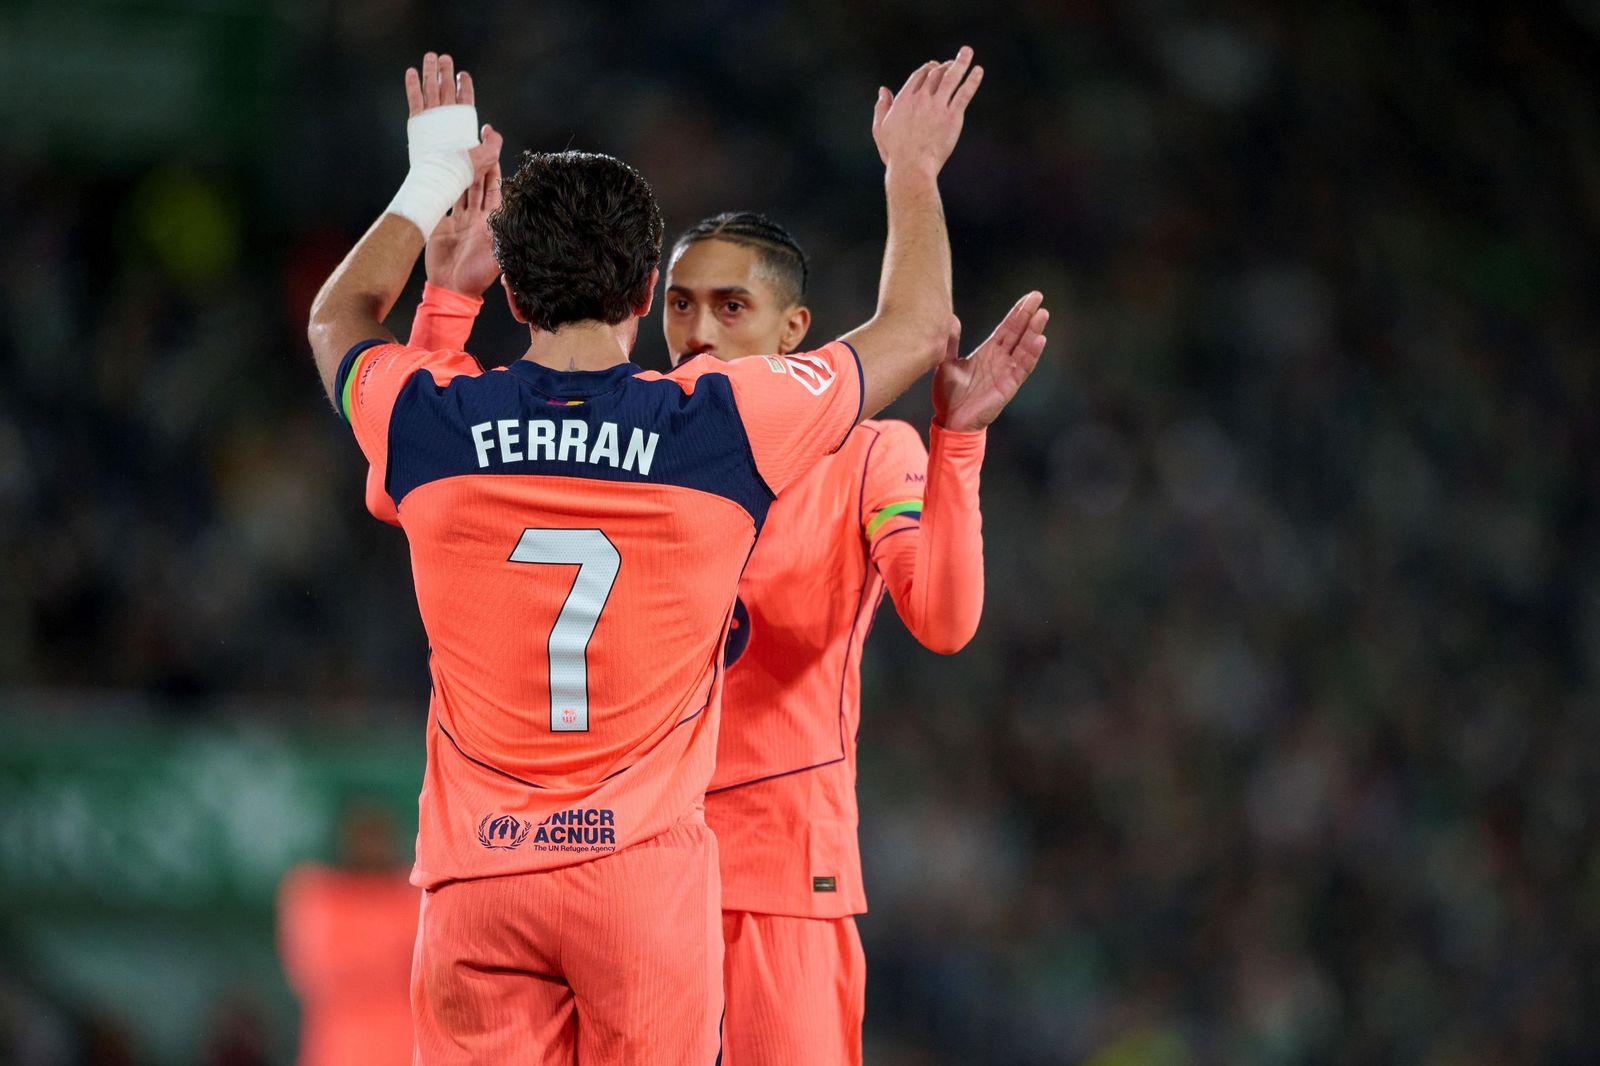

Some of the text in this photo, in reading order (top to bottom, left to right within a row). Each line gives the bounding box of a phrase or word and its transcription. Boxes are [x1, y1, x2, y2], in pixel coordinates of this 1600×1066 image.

[470, 419, 660, 476] FERRAN
[508, 528, 621, 733] 7
[533, 827, 616, 844] ACNUR
[561, 845, 589, 853] Refugee
[590, 845, 616, 853] Agency
